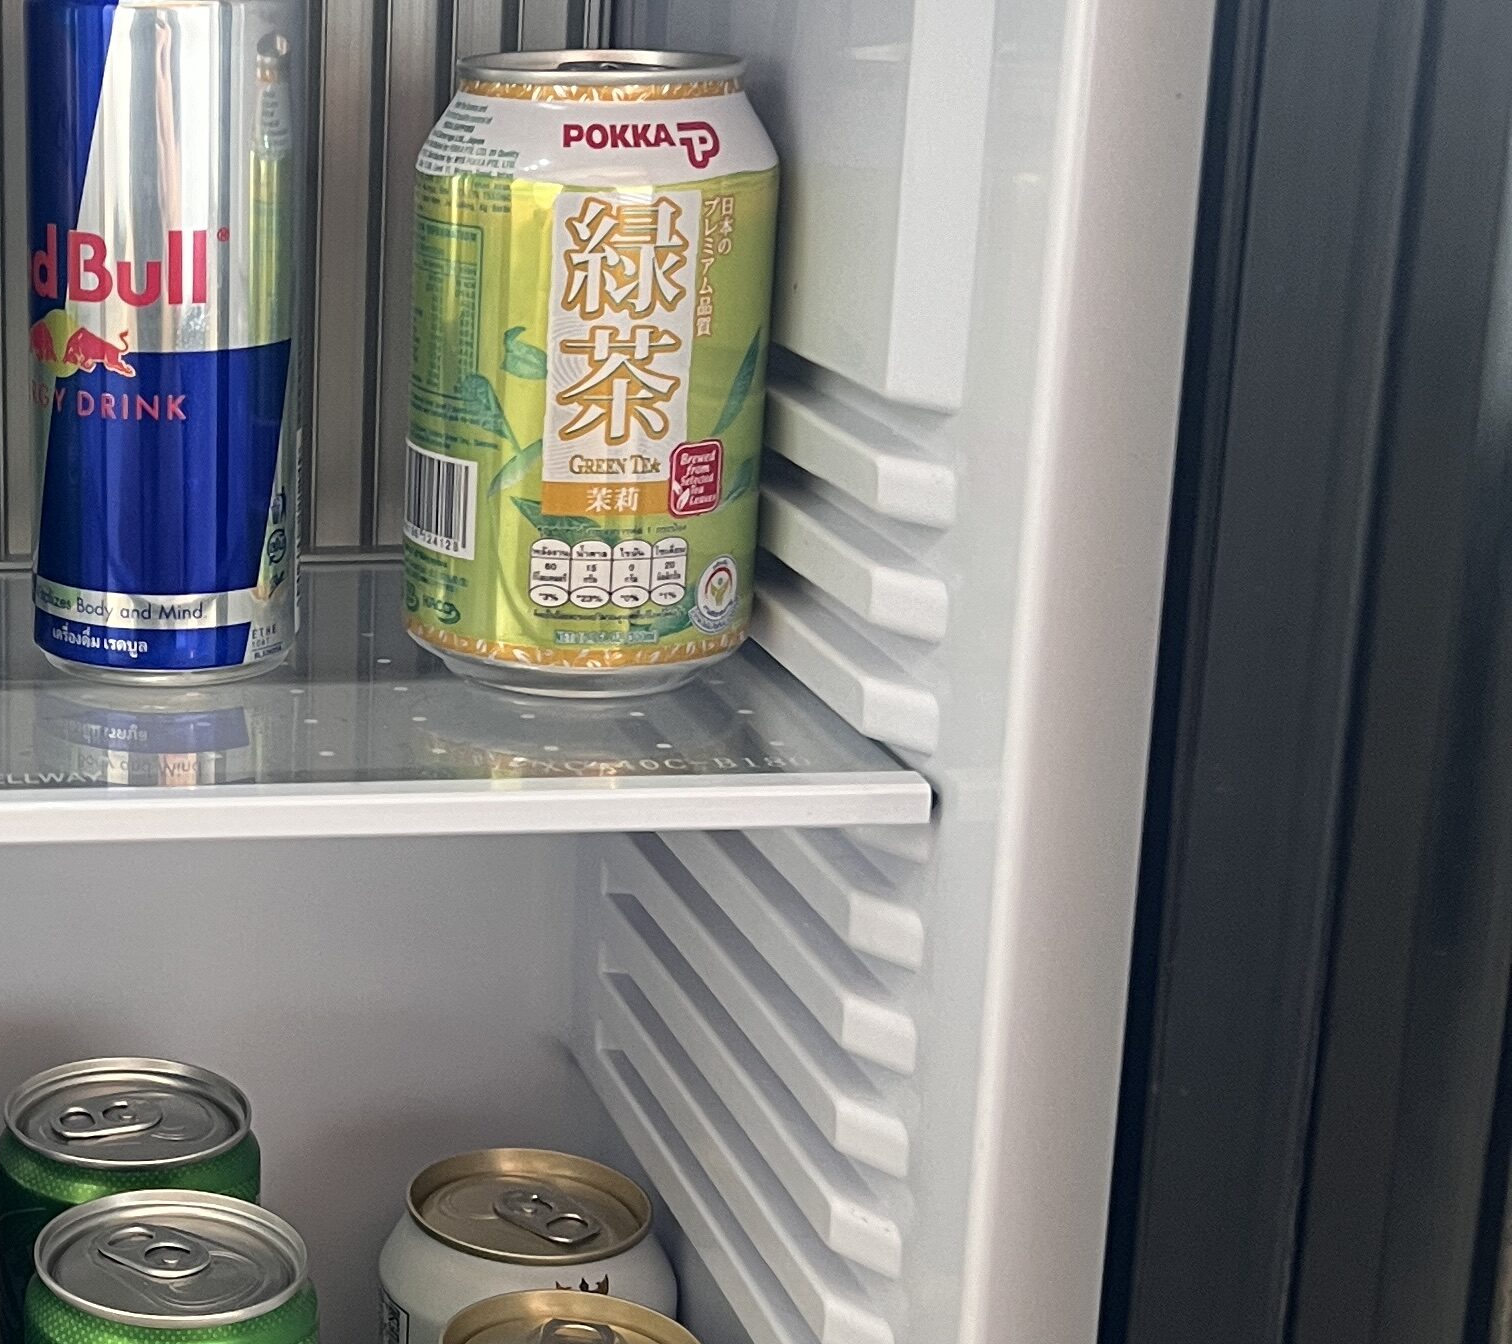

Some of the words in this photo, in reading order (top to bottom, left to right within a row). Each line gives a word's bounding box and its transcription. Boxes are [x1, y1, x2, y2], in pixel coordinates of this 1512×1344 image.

[562, 123, 675, 149] POKKA
[717, 196, 734, 255] 日本の
[66, 229, 208, 308] Bull
[76, 389, 187, 421] DRINK
[585, 487, 640, 513] 茉莉
[76, 596, 113, 619] Body
[120, 602, 152, 620] and
[52, 621, 101, 649] เครื่องดื่ม
[103, 636, 148, 659] เรดบูล
